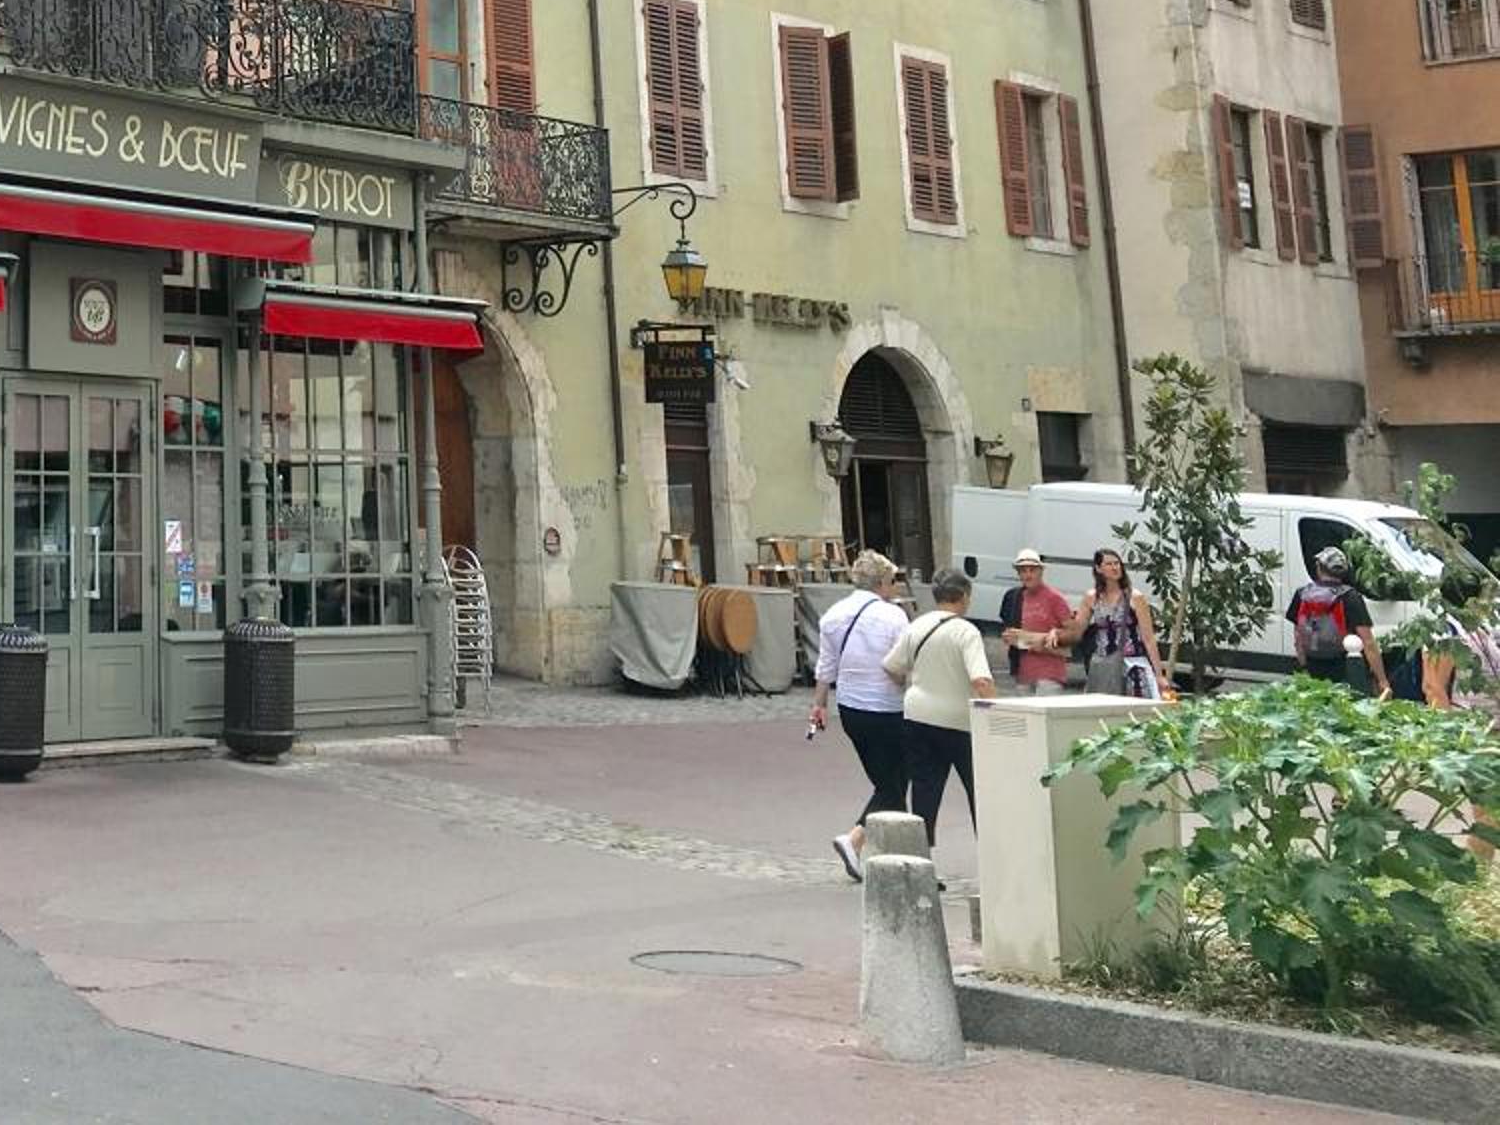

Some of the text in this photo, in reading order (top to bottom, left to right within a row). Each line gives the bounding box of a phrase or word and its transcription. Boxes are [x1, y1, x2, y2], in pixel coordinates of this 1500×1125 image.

[118, 114, 146, 164] &
[159, 120, 249, 179] BŒUF
[278, 152, 396, 219] BISTROT
